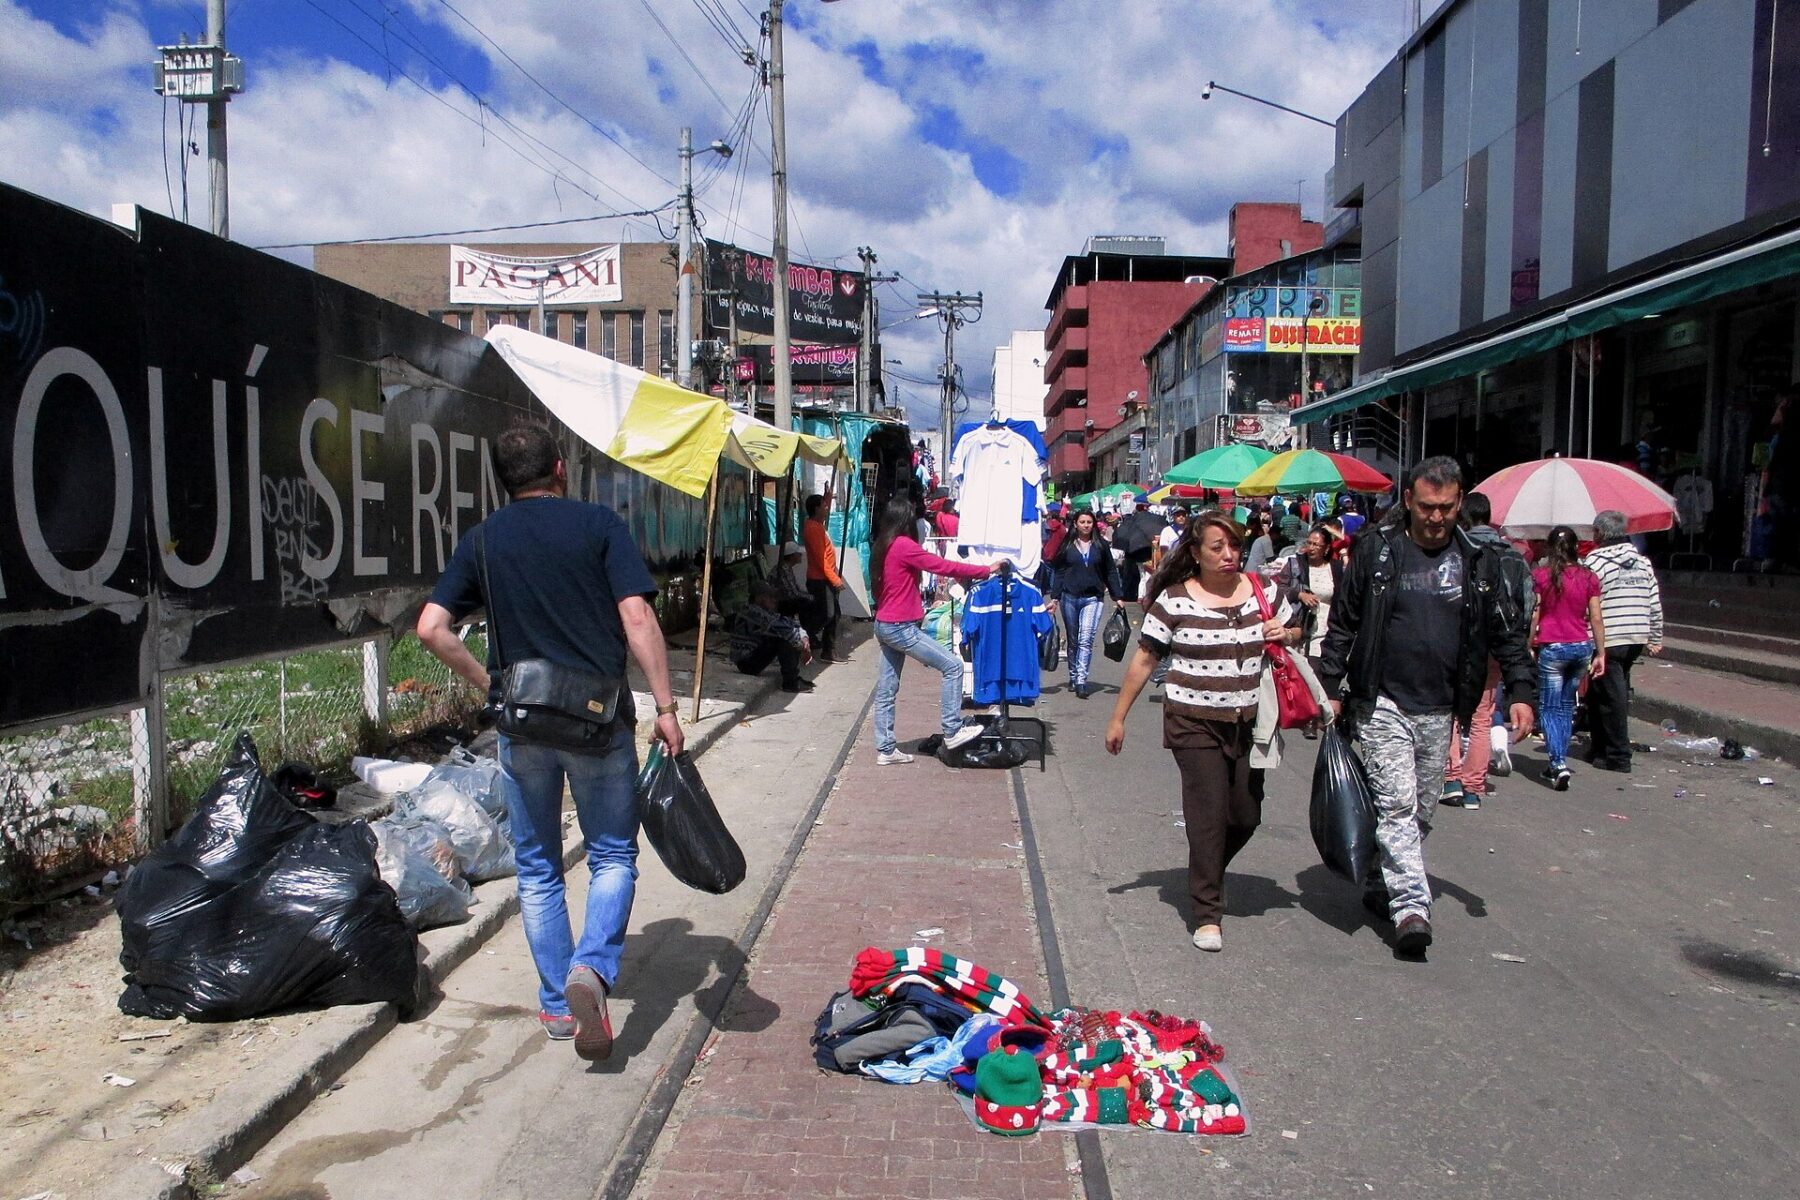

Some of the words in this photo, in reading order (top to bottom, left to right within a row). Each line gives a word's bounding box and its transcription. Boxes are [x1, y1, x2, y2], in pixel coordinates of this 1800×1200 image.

[455, 258, 617, 289] PAGANI
[793, 309, 803, 321] de
[826, 317, 843, 329] para
[1228, 328, 1261, 338] REMATE
[1269, 325, 1362, 346] DISFRACES
[0, 344, 269, 603] QUÍ
[299, 397, 389, 580] SE
